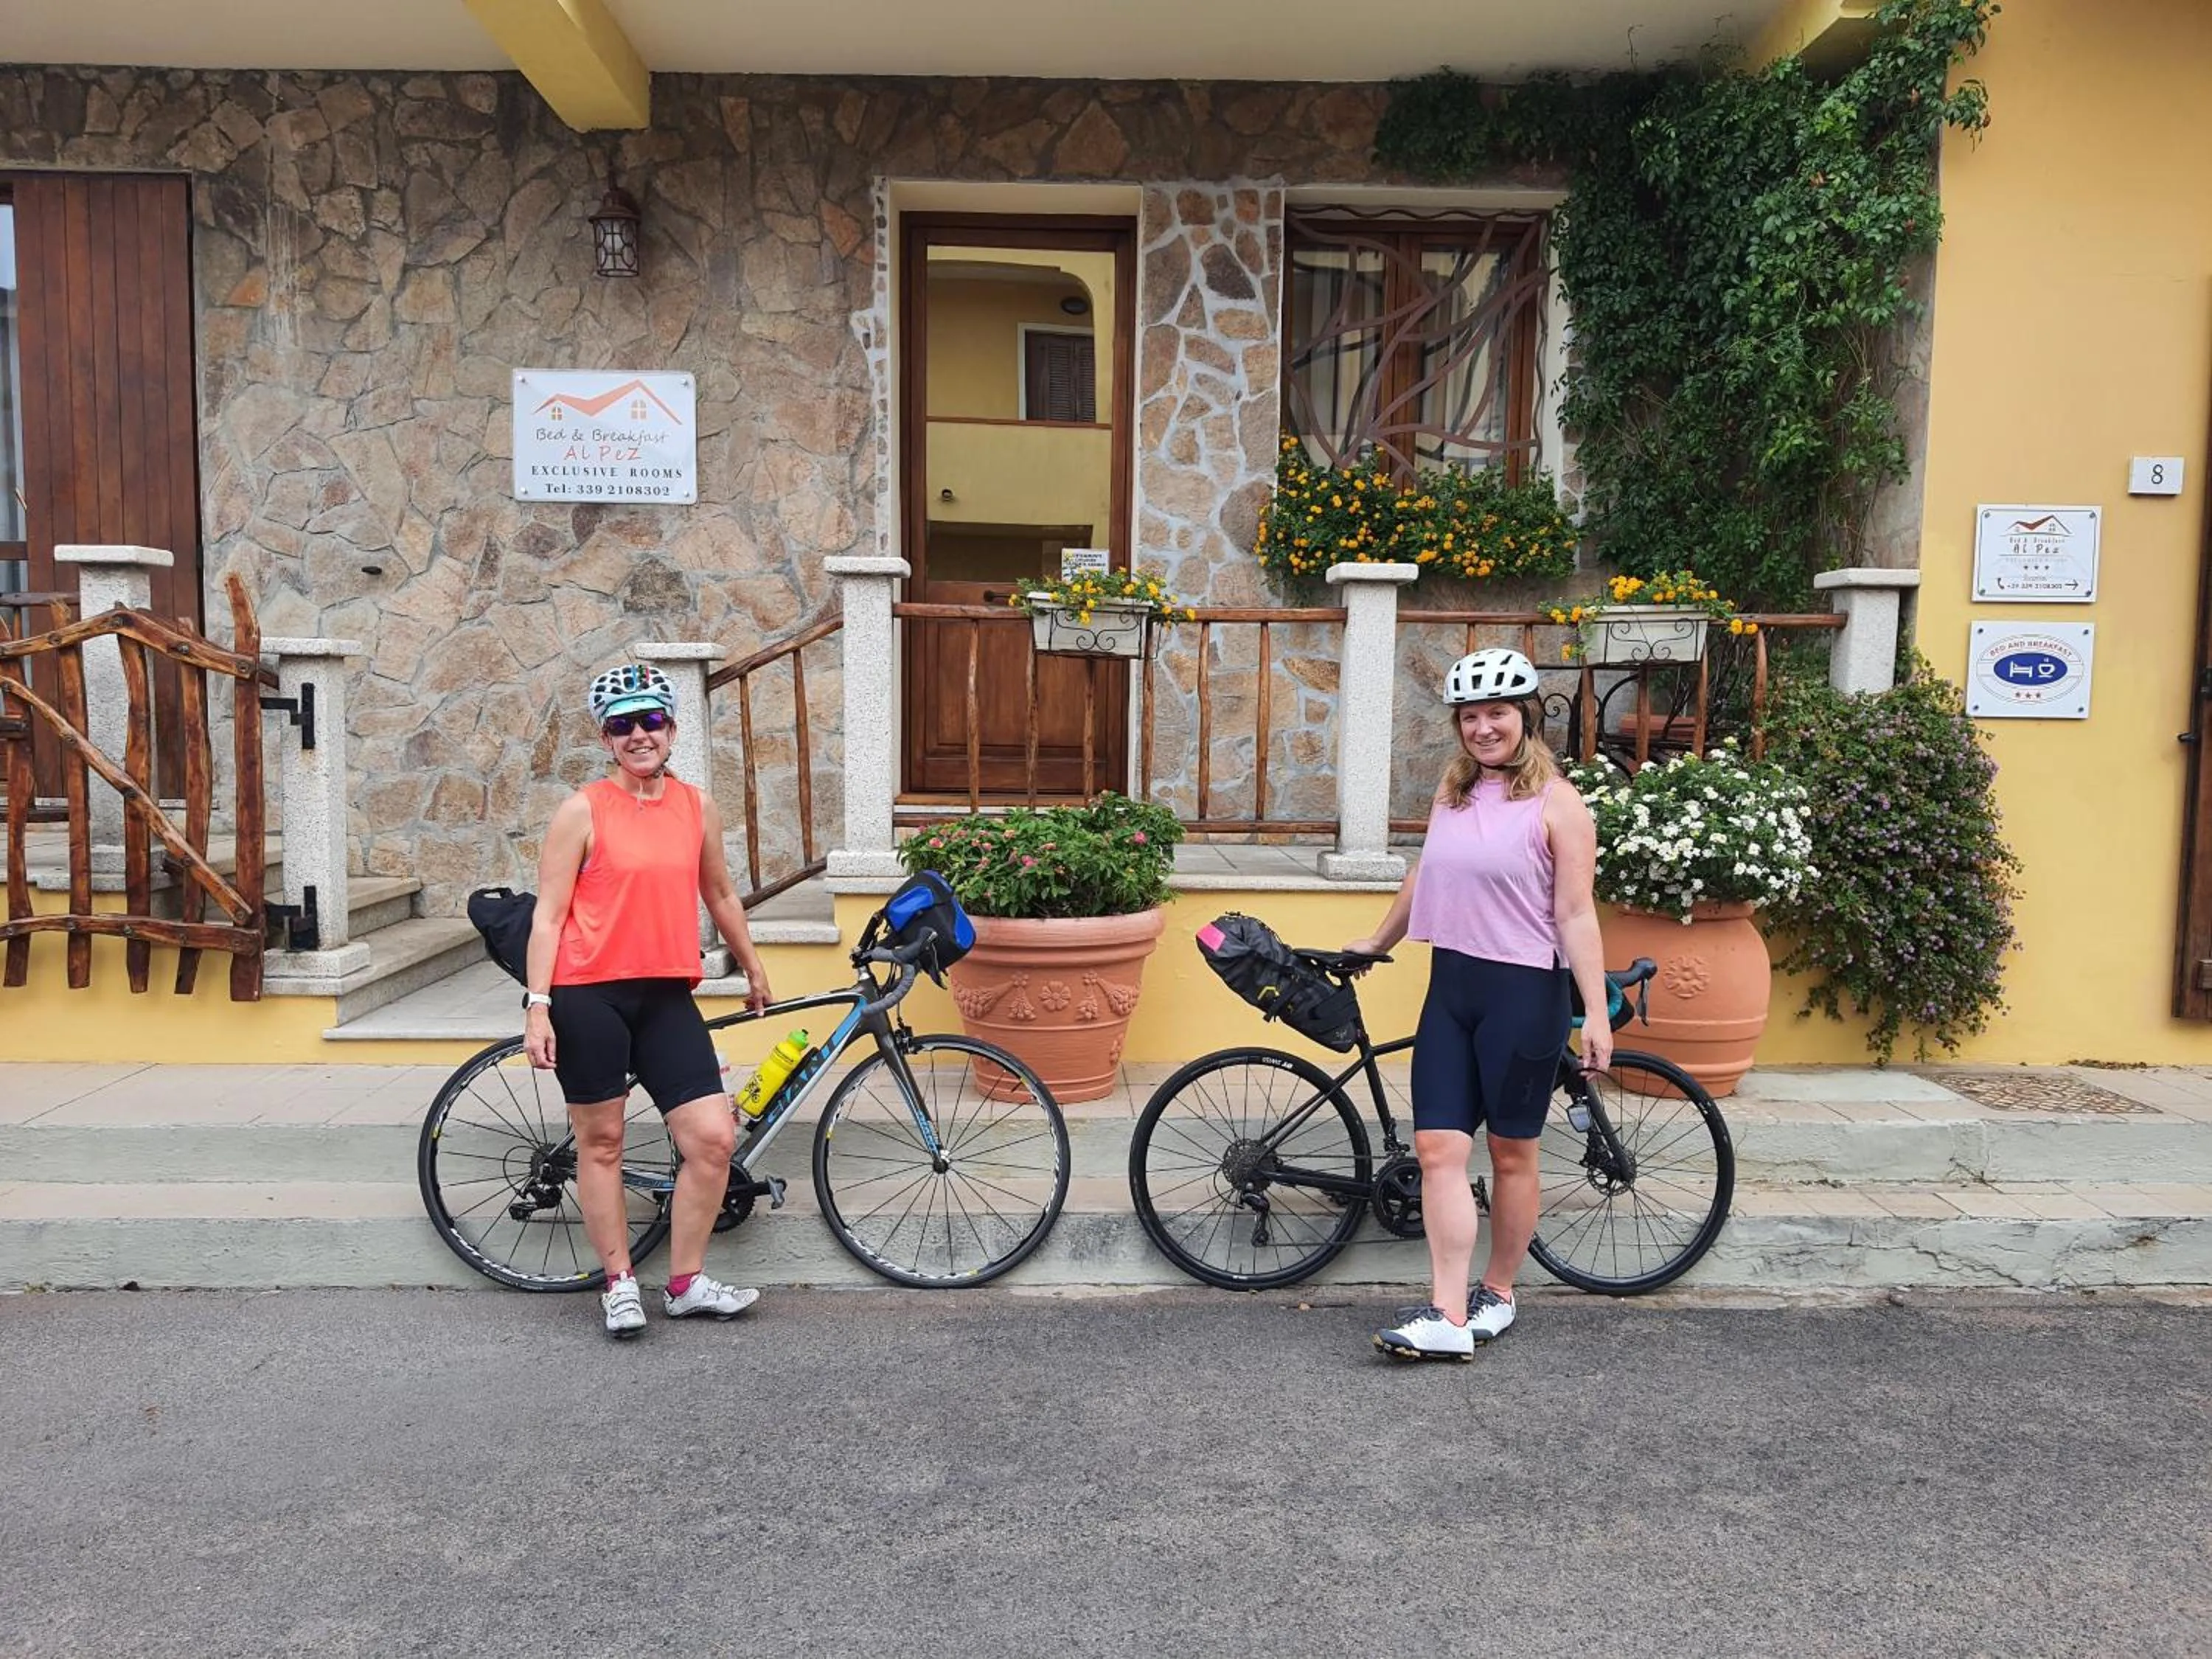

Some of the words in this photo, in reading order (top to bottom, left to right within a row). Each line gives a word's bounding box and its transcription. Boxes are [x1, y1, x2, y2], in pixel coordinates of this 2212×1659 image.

[536, 428, 566, 441] Bed
[571, 428, 584, 442] &
[591, 428, 669, 445] Breakfast
[531, 465, 618, 477] EXCLUSIVE
[630, 467, 683, 479] ROOMS
[2151, 464, 2164, 484] 8
[545, 483, 572, 493] Tel:
[577, 484, 603, 495] 339
[607, 484, 670, 496] 2108302
[1989, 645, 2006, 656] BED
[2008, 641, 2025, 649] AND
[2028, 641, 2073, 657] BREAKFAST
